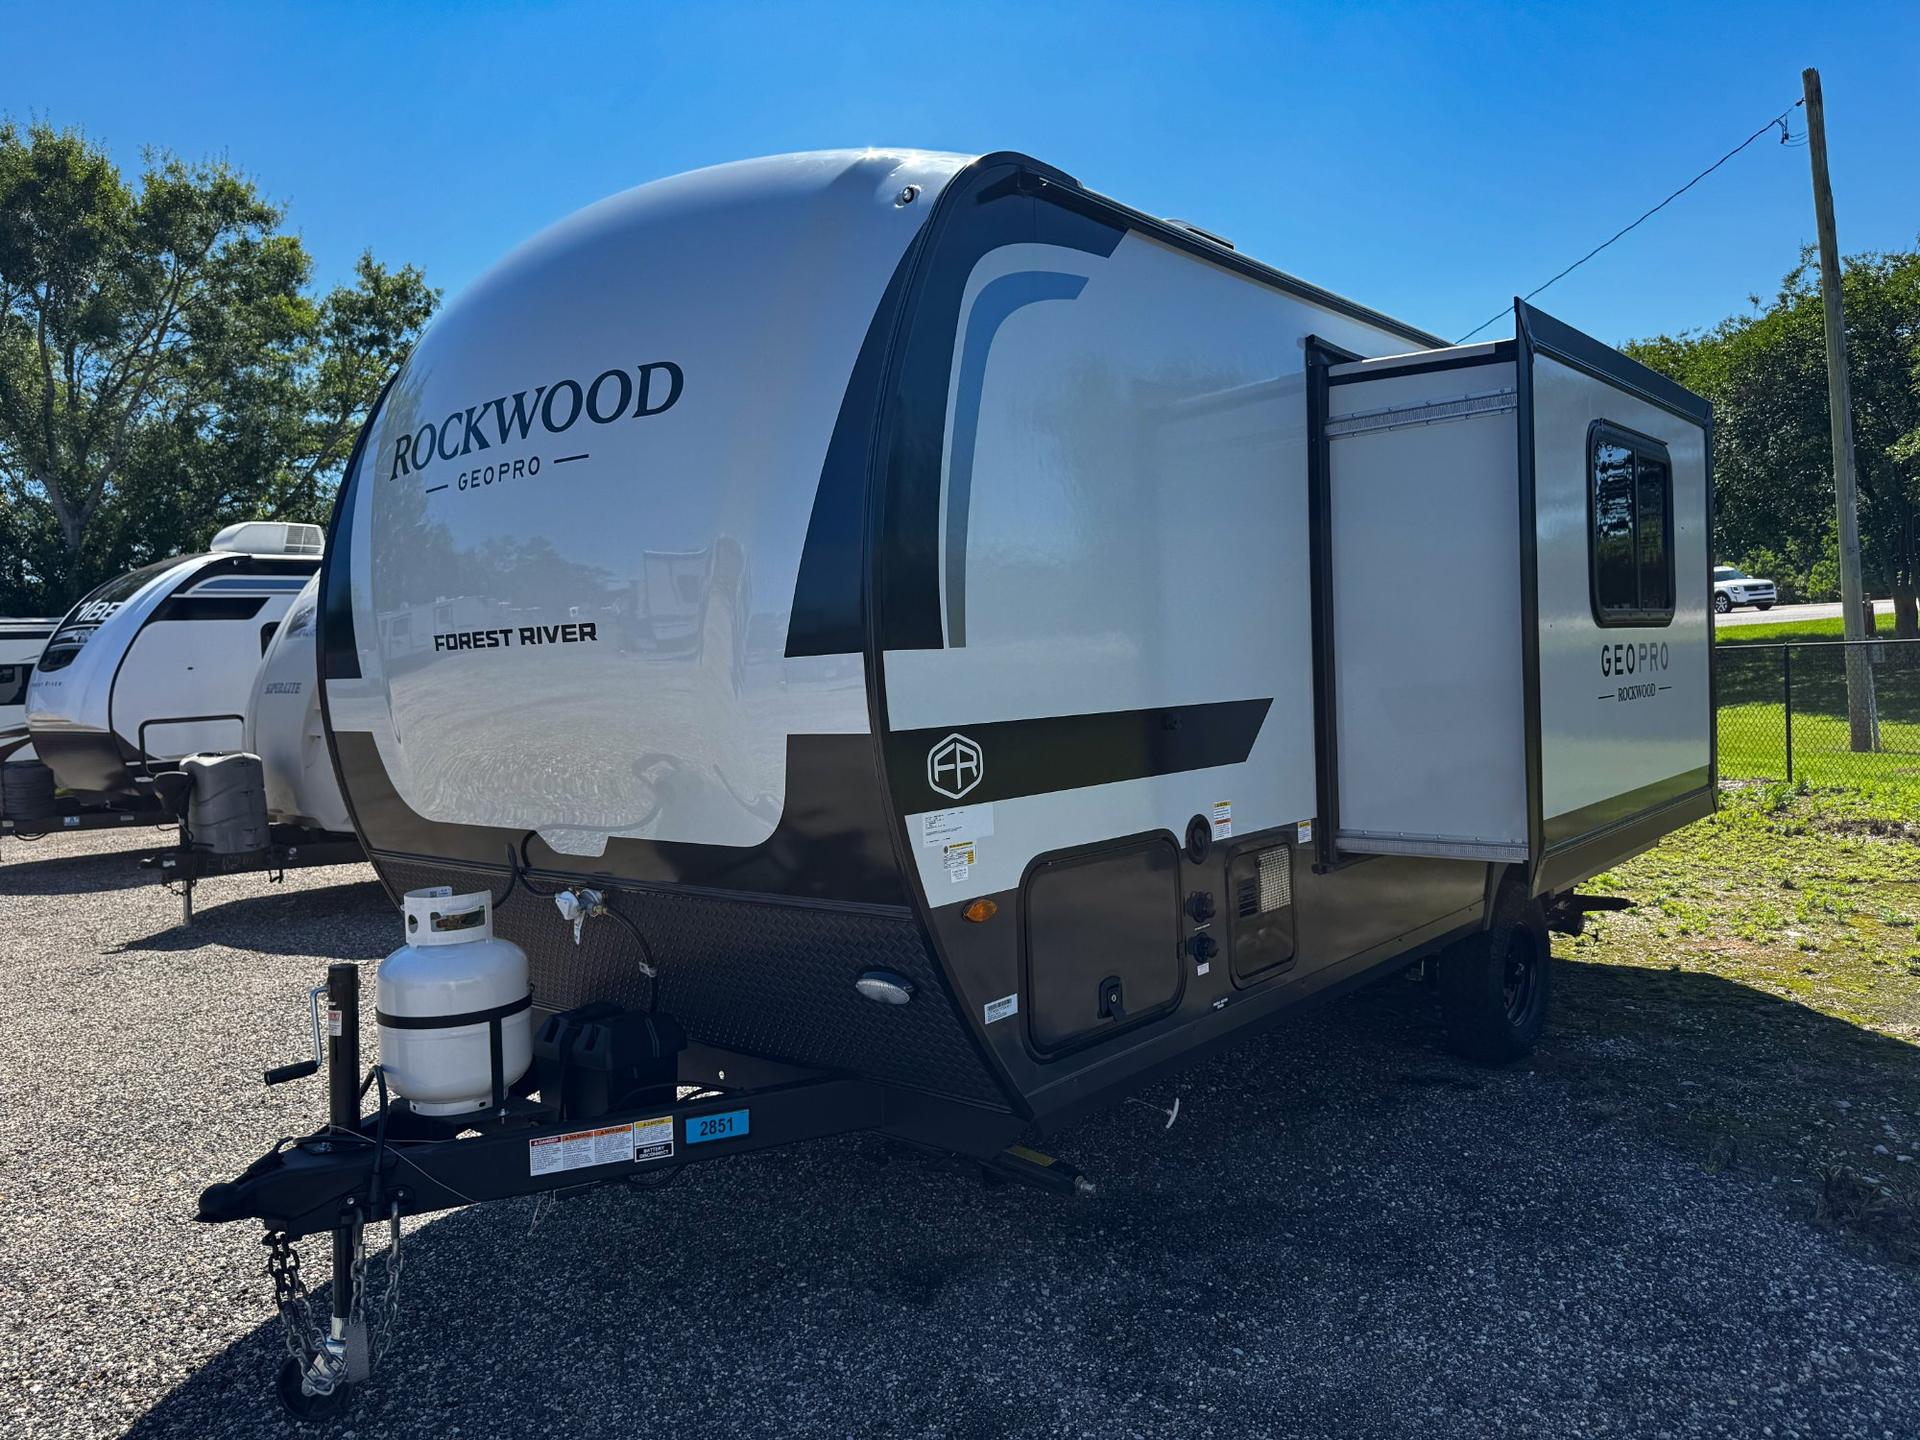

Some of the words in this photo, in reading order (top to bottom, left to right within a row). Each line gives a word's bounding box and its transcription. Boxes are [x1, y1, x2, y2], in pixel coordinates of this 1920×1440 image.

[389, 361, 684, 482] ROCKWOOD
[458, 455, 541, 492] GEOPRO
[433, 629, 513, 652] FOREST
[518, 622, 598, 646] RIVER
[1601, 641, 1669, 677] GEOPRO
[1618, 683, 1656, 702] ROCKWOOD
[701, 1117, 734, 1137] 2851
